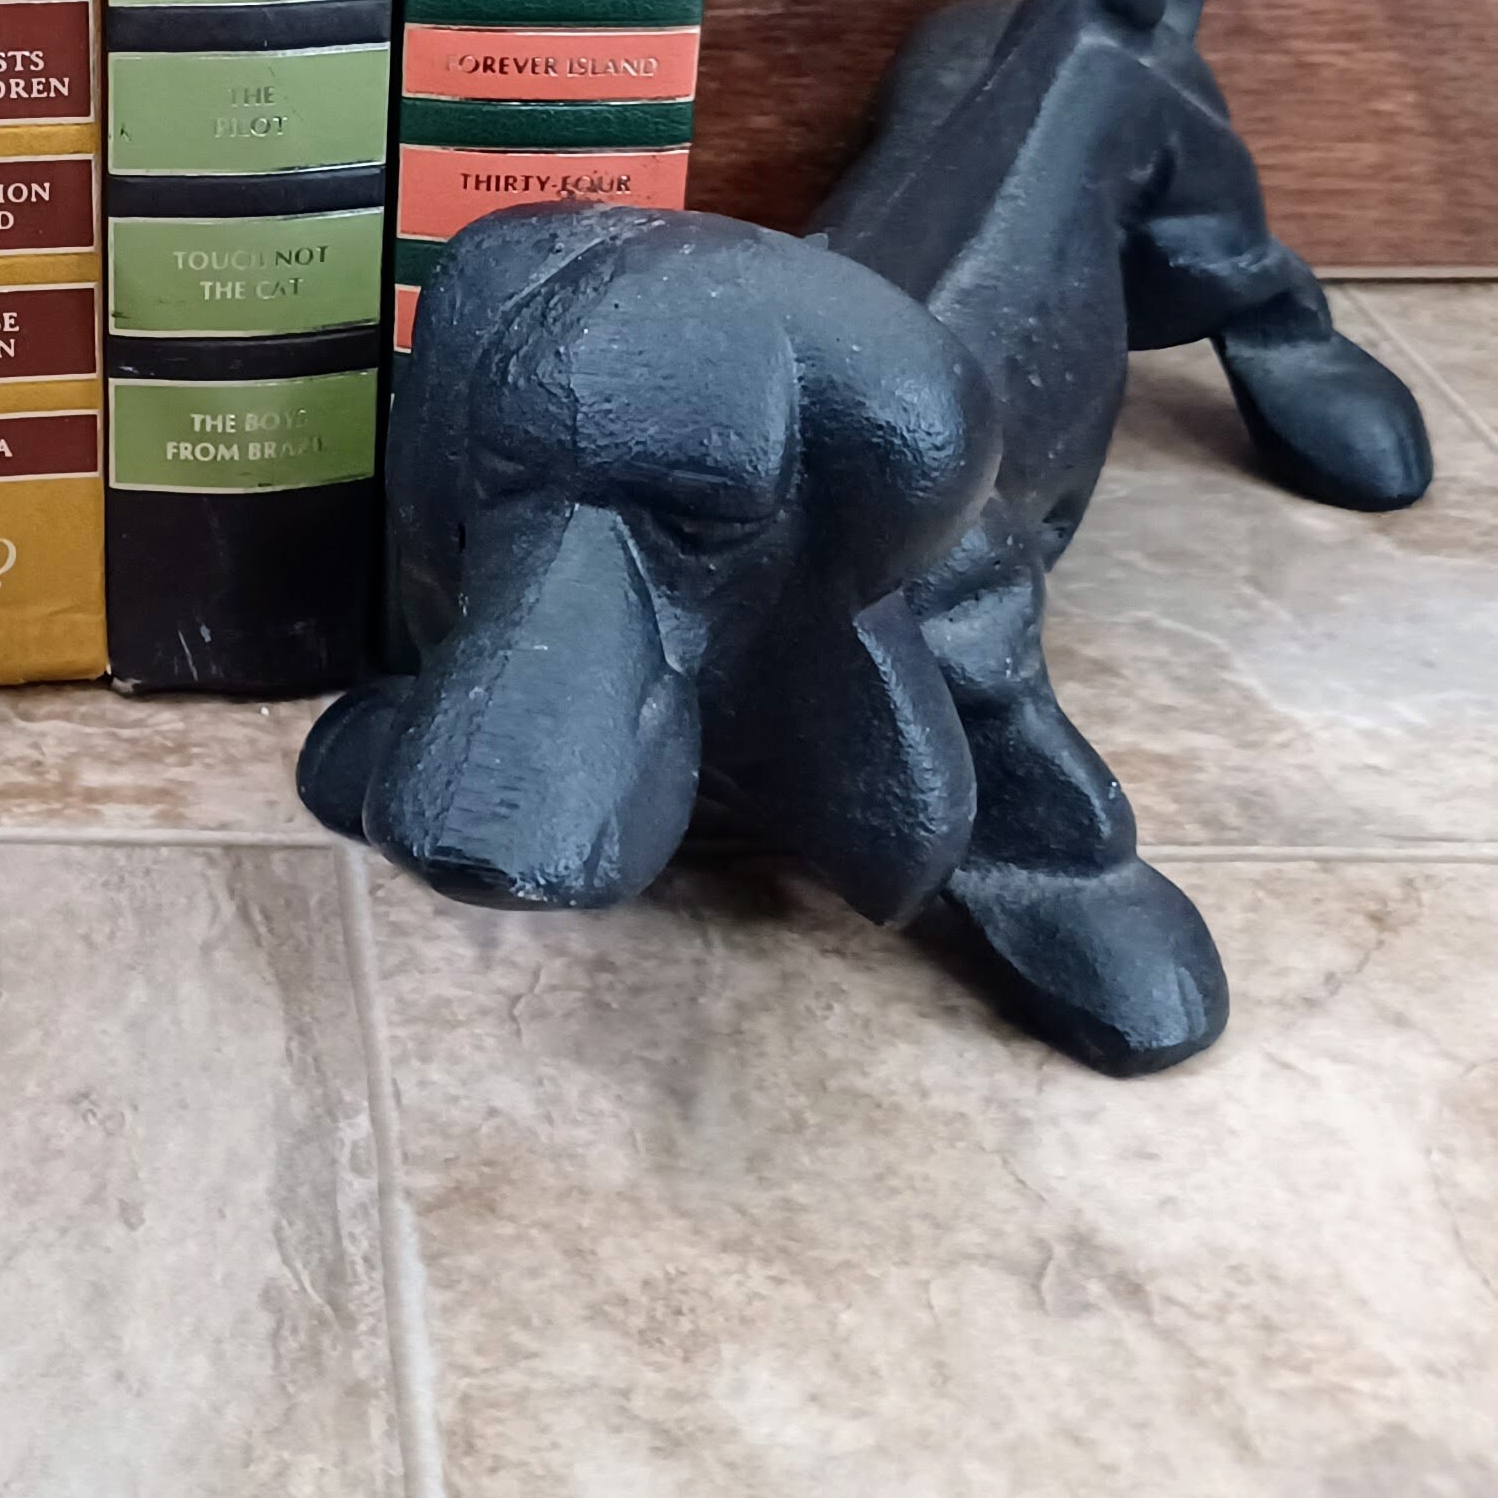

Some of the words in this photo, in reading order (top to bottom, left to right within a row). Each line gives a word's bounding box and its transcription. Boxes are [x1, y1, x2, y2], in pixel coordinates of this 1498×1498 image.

[566, 56, 660, 78] ISLAND
[230, 85, 277, 107] THE
[214, 116, 288, 138] PILOT
[460, 171, 632, 196] THIRTY-FOUR
[275, 245, 329, 266] NOT
[199, 280, 246, 300] THE
[254, 277, 303, 299] CAT
[190, 413, 236, 433] THE
[166, 441, 240, 462] FROM
